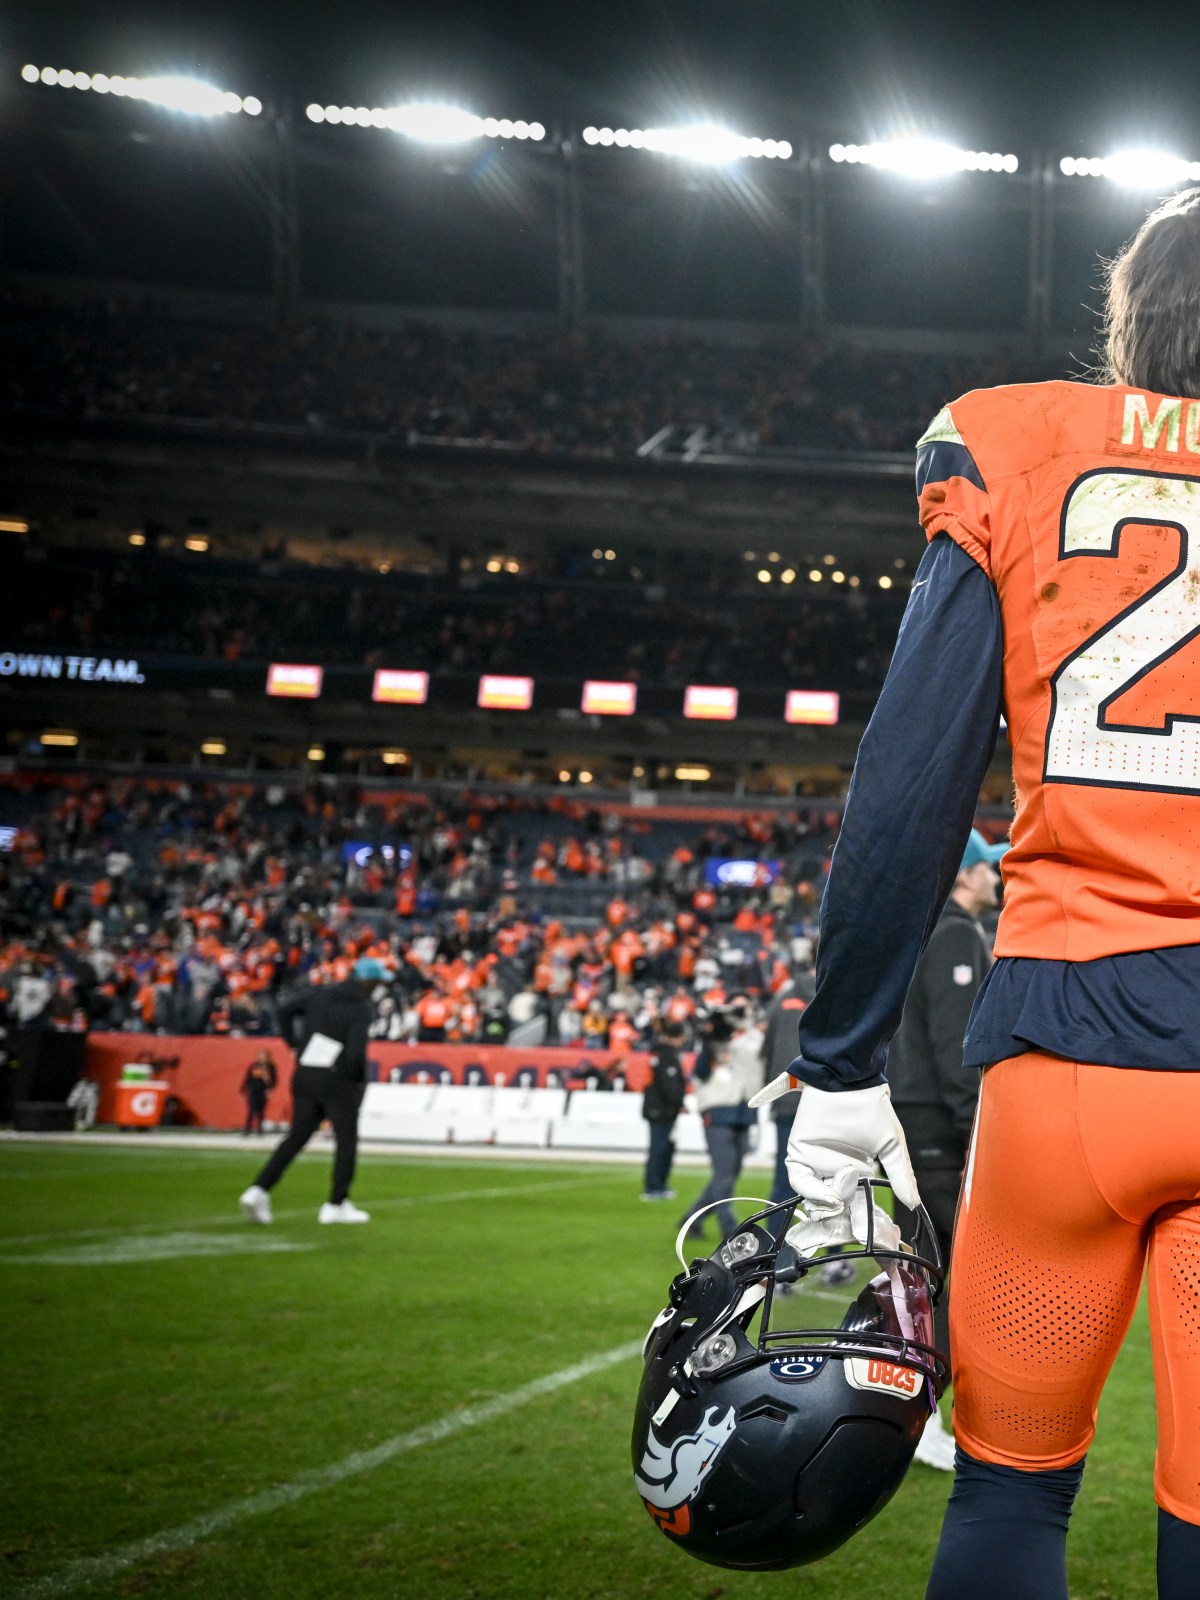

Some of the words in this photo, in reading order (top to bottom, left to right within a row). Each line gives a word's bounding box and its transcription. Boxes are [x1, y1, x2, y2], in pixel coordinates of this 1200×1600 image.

[0, 652, 63, 679] OWN
[65, 655, 145, 684] TEAM.
[773, 1354, 823, 1364] OAKLEY
[867, 1359, 917, 1393] 5280
